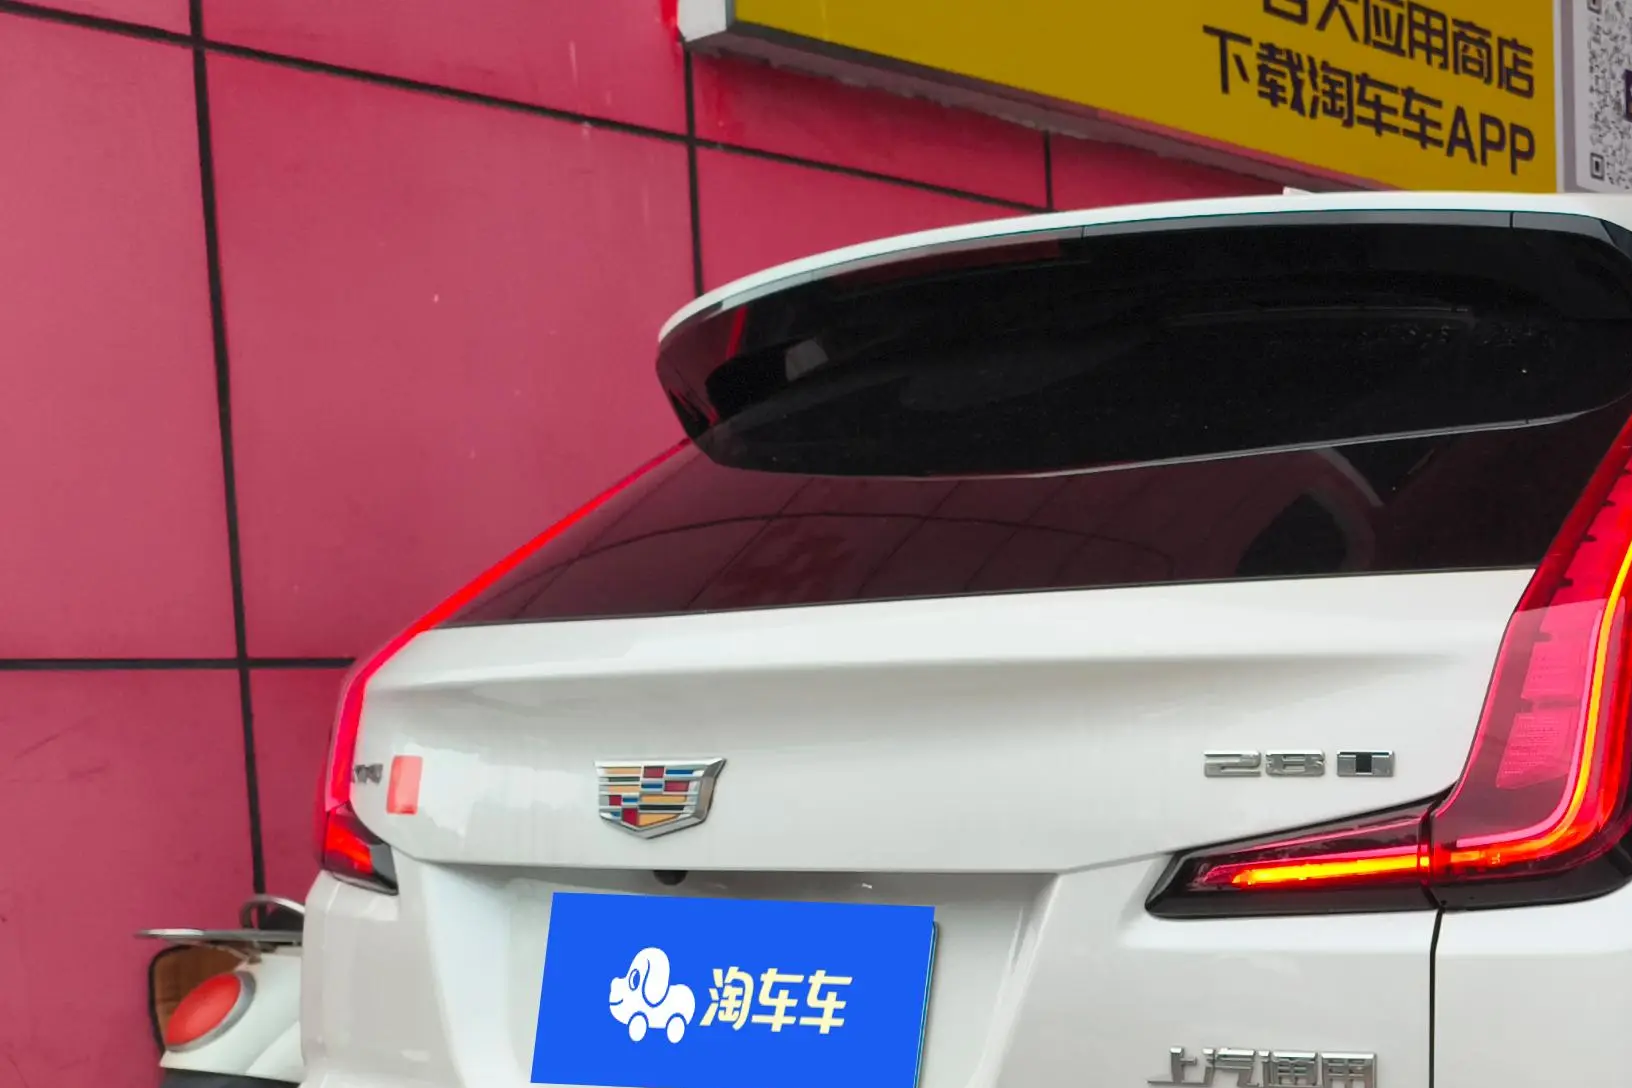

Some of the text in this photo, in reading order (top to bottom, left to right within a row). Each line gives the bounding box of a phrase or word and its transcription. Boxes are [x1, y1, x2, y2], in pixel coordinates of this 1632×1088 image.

[1202, 25, 1537, 176] 下载淘车车APP
